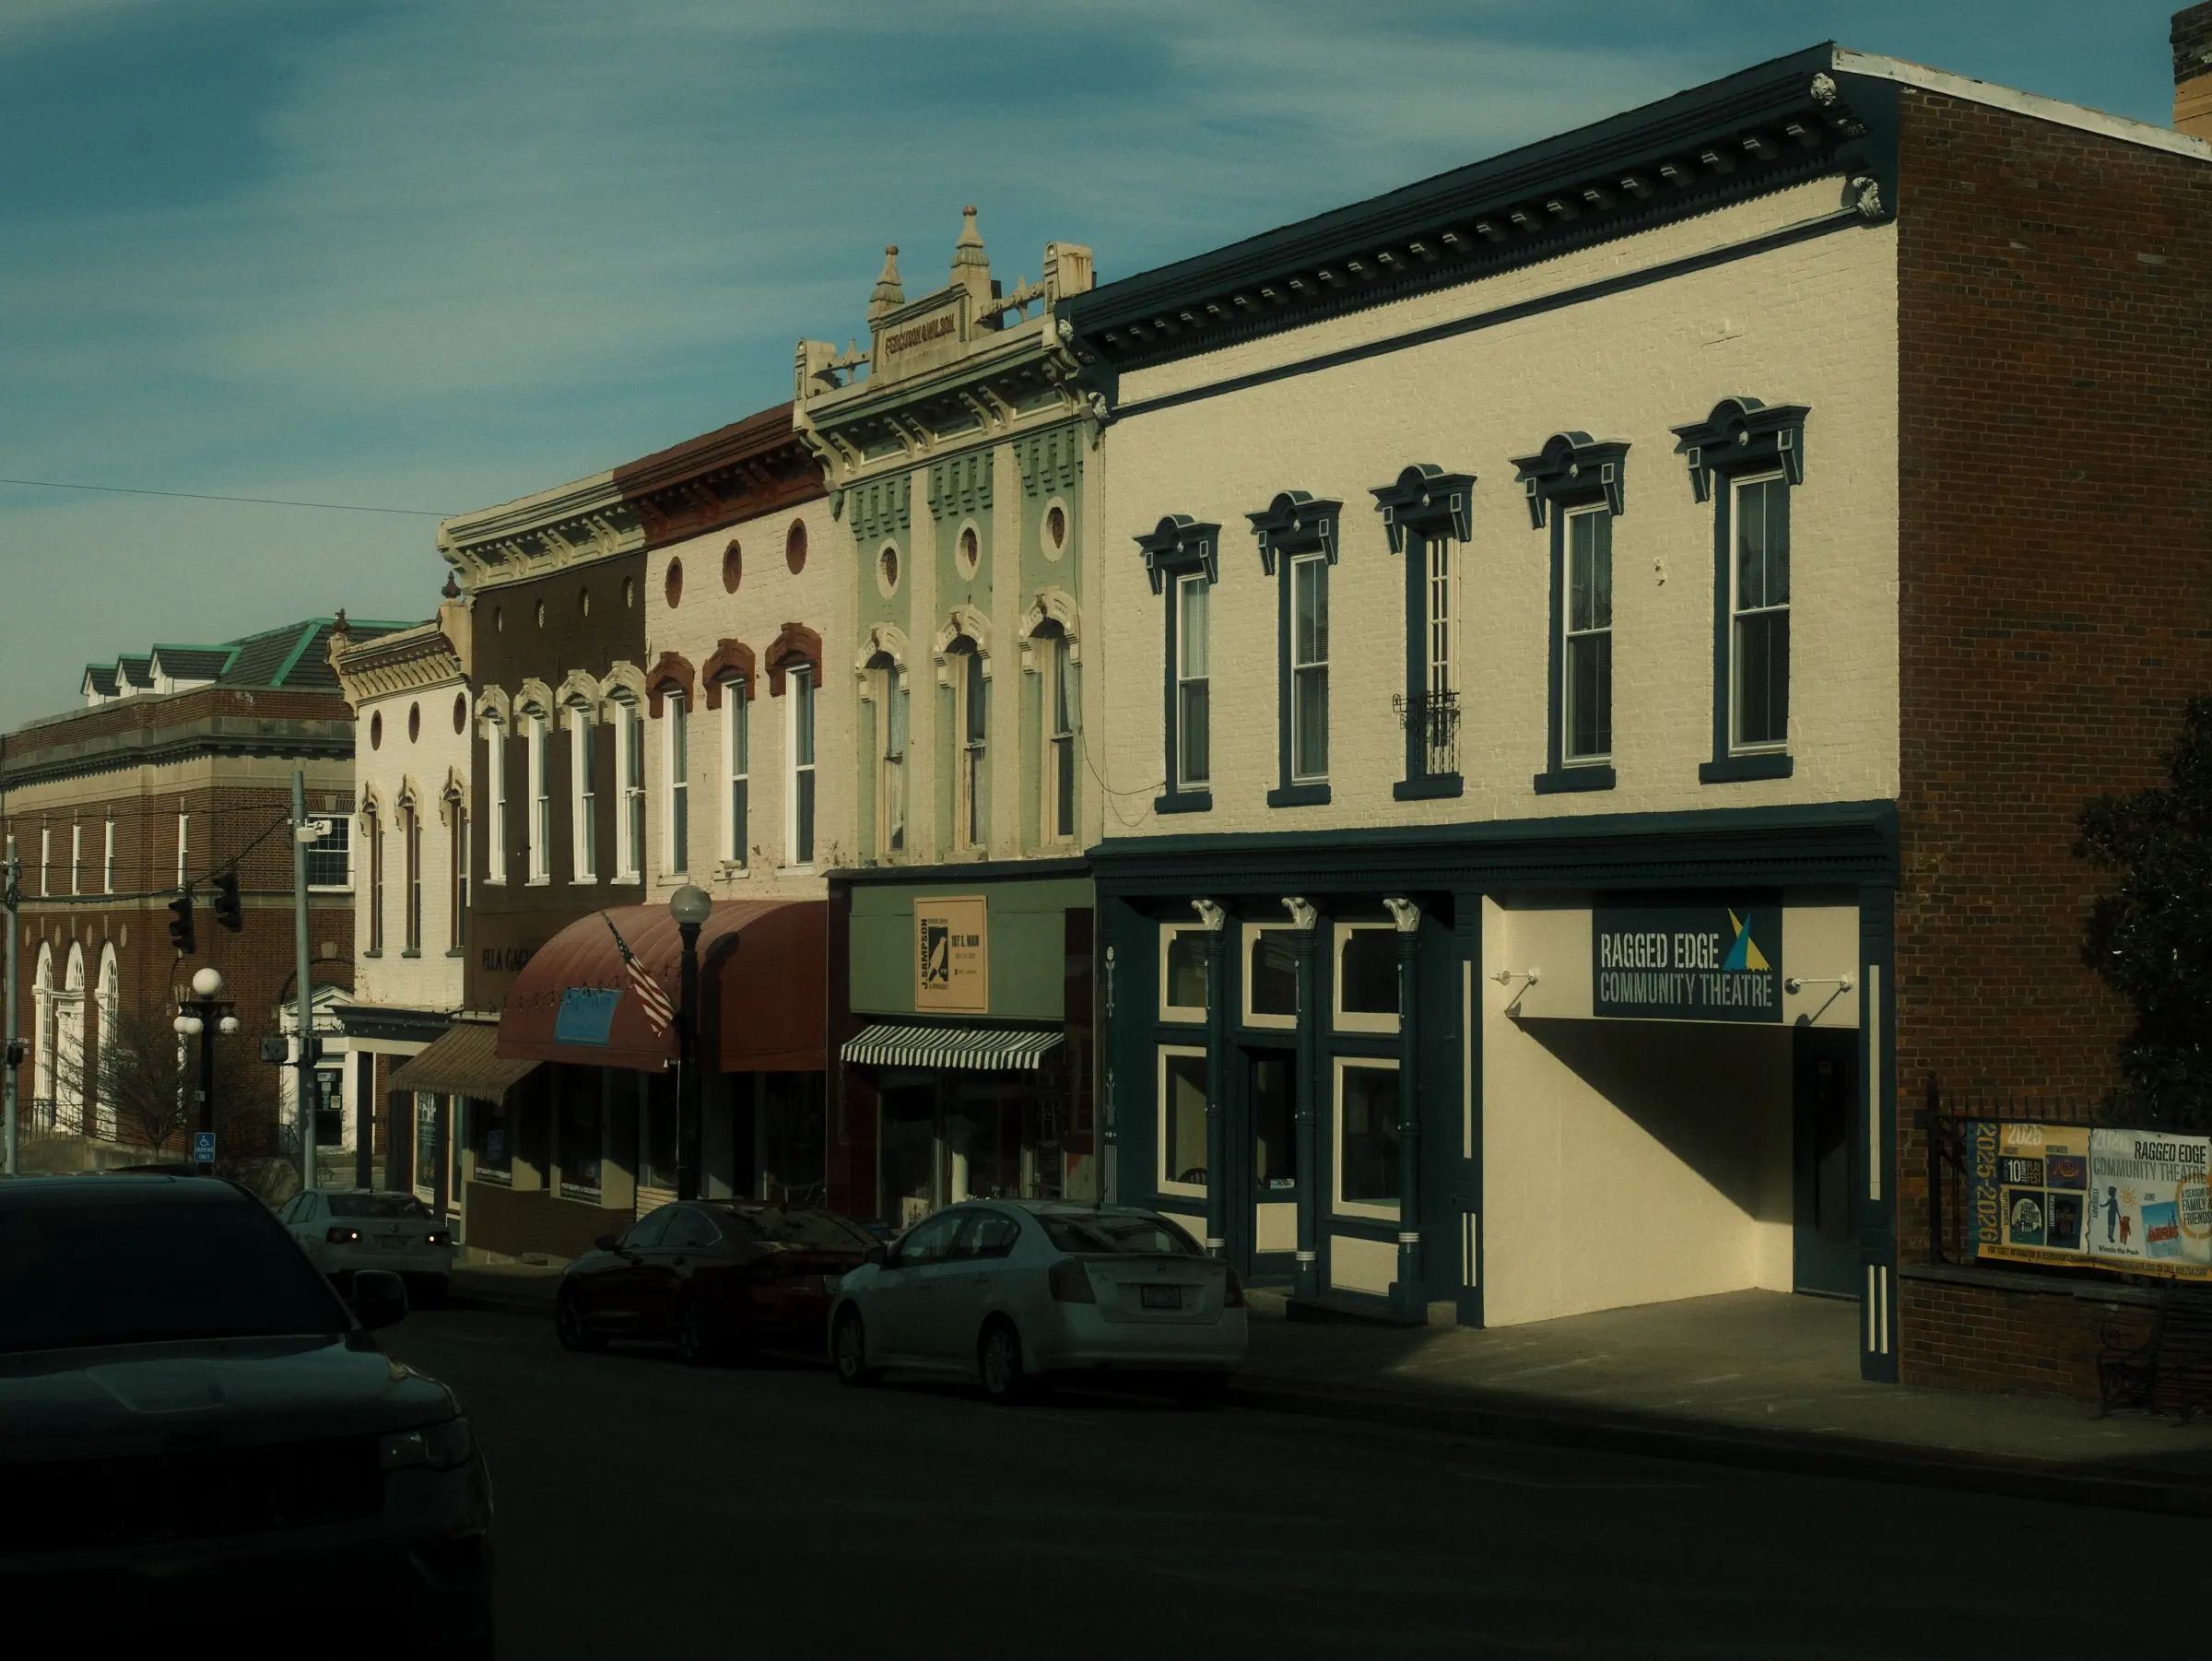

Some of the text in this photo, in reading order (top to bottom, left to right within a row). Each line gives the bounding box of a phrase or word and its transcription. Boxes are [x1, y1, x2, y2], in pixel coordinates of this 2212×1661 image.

[926, 313, 955, 340] WILSON
[1601, 933, 1720, 970] RAGGED EDGE
[1600, 972, 1773, 1007] COMMUNITY THEATRE
[2007, 1123, 2042, 1147] 2025
[2135, 1140, 2206, 1165] RAGGED EDGE
[2007, 1159, 2021, 1183] 10
[2027, 1160, 2041, 1172] PLAY
[2027, 1172, 2042, 1184] FEST
[2093, 1157, 2157, 1181] COMMUNITY
[2158, 1162, 2206, 1184] THEATRE
[1975, 1123, 1999, 1242] 2025-2026
[2185, 1187, 2206, 1198] SEASON
[2144, 1193, 2156, 1202] JUNE
[2183, 1198, 2206, 1211] FAMILY
